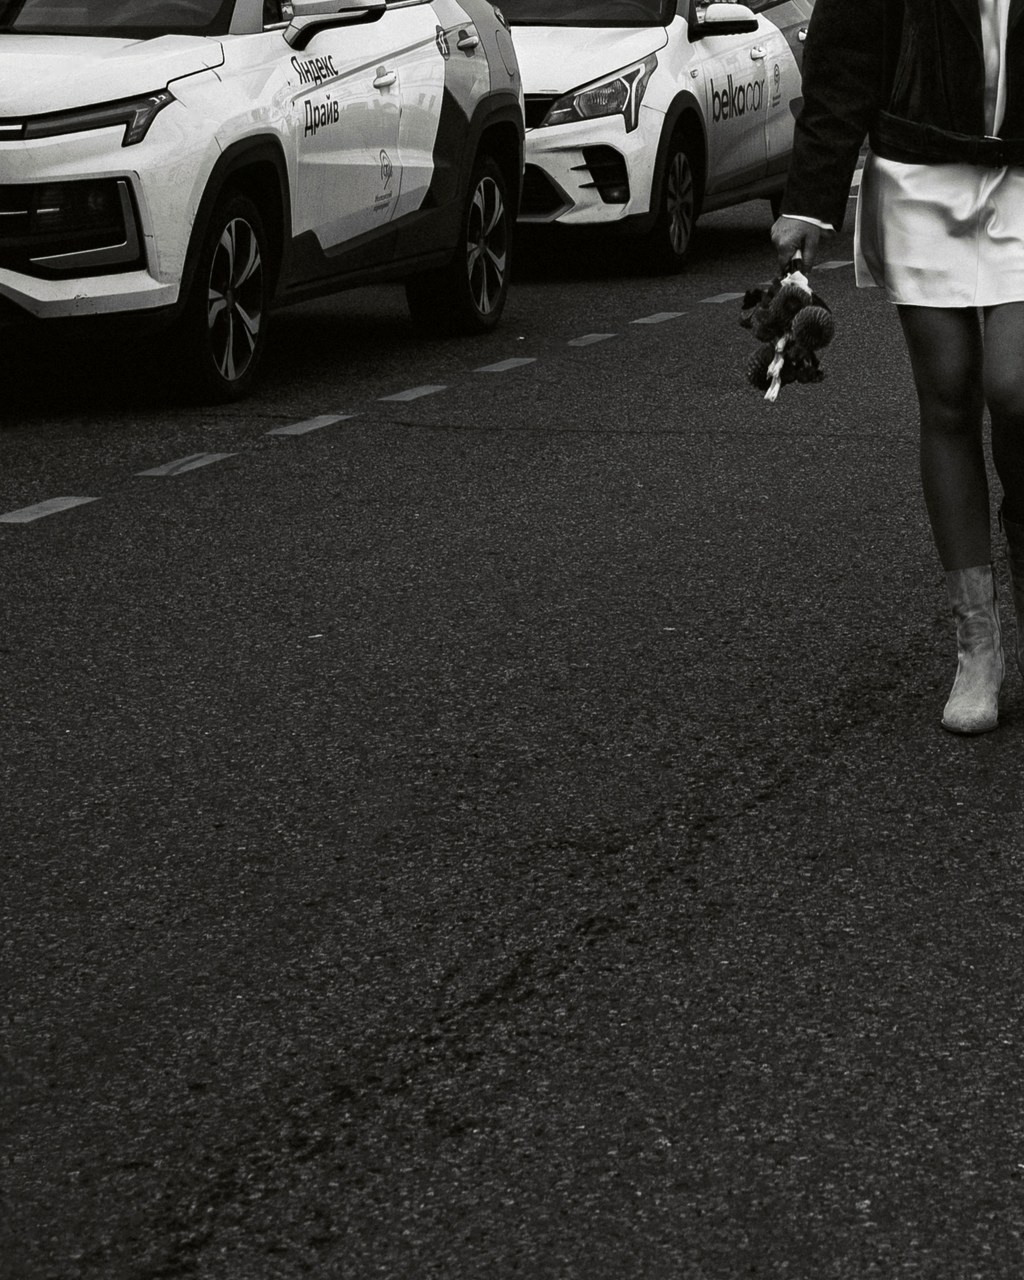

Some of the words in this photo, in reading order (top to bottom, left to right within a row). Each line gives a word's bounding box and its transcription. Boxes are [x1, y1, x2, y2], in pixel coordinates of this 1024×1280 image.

[291, 55, 339, 86] Яндекс
[304, 94, 339, 138] Драйв
[710, 74, 765, 123] belkacar
